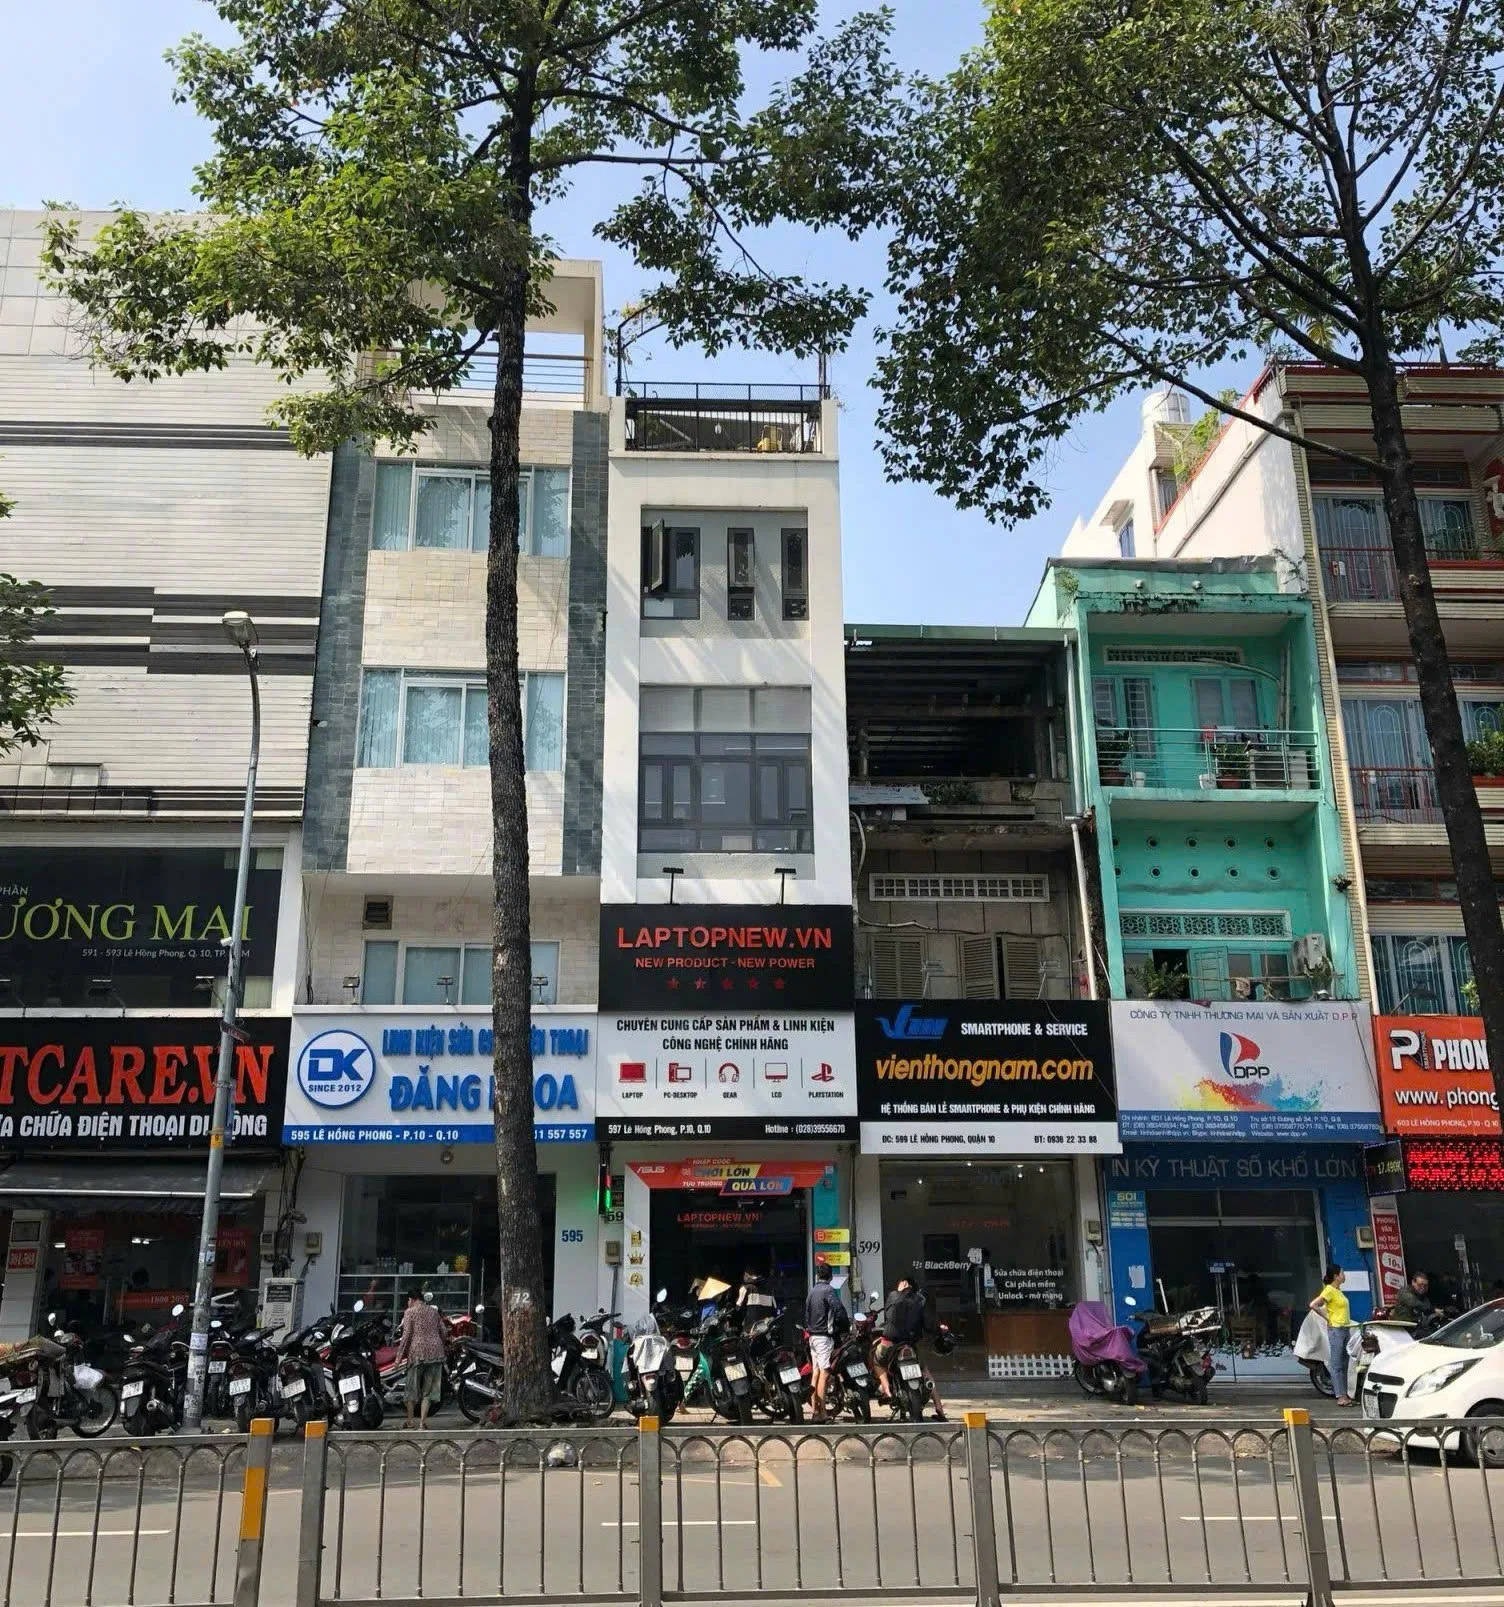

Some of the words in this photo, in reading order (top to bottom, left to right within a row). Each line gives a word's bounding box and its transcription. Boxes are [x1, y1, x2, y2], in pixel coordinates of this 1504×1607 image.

[150, 904, 255, 941] MAI
[616, 926, 833, 949] LAPTOPNEW.VN
[82, 948, 97, 957] 591
[105, 948, 122, 957] 593
[123, 948, 133, 957] Lê
[635, 957, 662, 969] NEW
[667, 957, 729, 969] PRODUCT
[738, 957, 766, 969] NEW
[769, 957, 816, 969] POWER
[1160, 1010, 1172, 1019] TY
[1174, 1011, 1201, 1020] TNHH
[616, 1017, 658, 1032] CHUYÊN
[660, 1019, 690, 1031] CUNG
[692, 1014, 713, 1031] CẤP
[715, 1015, 737, 1031] SẢN
[739, 1014, 770, 1031] PHẨM
[772, 1019, 780, 1031] &
[783, 1019, 807, 1032] LINH
[810, 1017, 835, 1034] KIỆN
[960, 1022, 1031, 1036] SMARTPHONE
[1035, 1023, 1043, 1035] &
[1046, 1023, 1088, 1036] SERVICE
[662, 1036, 692, 1050] CÔNG
[694, 1036, 722, 1052] NGHỆ
[725, 1036, 758, 1050] CHÍNH
[307, 1048, 367, 1081] DK
[876, 1053, 1094, 1087] vienthongnam.com
[1233, 1066, 1270, 1079] DPP
[308, 1084, 336, 1093] SINCE
[338, 1083, 362, 1092] 2012
[622, 1091, 644, 1099] LAPTOP
[808, 1091, 844, 1099] PLAYSTATION
[881, 1102, 892, 1115] HỆ
[920, 1101, 936, 1114] BÁN
[949, 1103, 1001, 1114] SMARTPHONE
[1003, 1104, 1010, 1114] &
[1011, 1103, 1027, 1116] PHỤ
[1029, 1102, 1047, 1115] KIỆN
[0, 1114, 14, 1137] A
[20, 1110, 72, 1137] CHỮA
[77, 1111, 123, 1141] ĐIỆN
[129, 1115, 186, 1141] THOẠI
[189, 1115, 210, 1136] DI
[608, 1125, 622, 1134] 597
[290, 1129, 310, 1140] 595
[313, 1128, 325, 1140] LÊ
[358, 1129, 393, 1140] PHONG
[403, 1130, 425, 1140] P.10
[435, 1129, 459, 1140] Q.10
[547, 1129, 565, 1139] 557
[569, 1128, 587, 1139] 557
[1066, 1135, 1075, 1143] 22
[636, 1166, 665, 1174] ASUS
[727, 1167, 751, 1177] LỚN
[1111, 1158, 1130, 1177] IN
[1167, 1156, 1230, 1181] THUẬT
[1314, 1154, 1358, 1177] LỚN
[562, 1230, 583, 1243] 595
[858, 1240, 880, 1254] 599
[924, 1260, 971, 1271] BlackBerry
[1027, 1268, 1044, 1278] điện
[1045, 1268, 1064, 1278] thoại
[513, 1292, 531, 1304] 72
[998, 1292, 1024, 1300] Unlock
